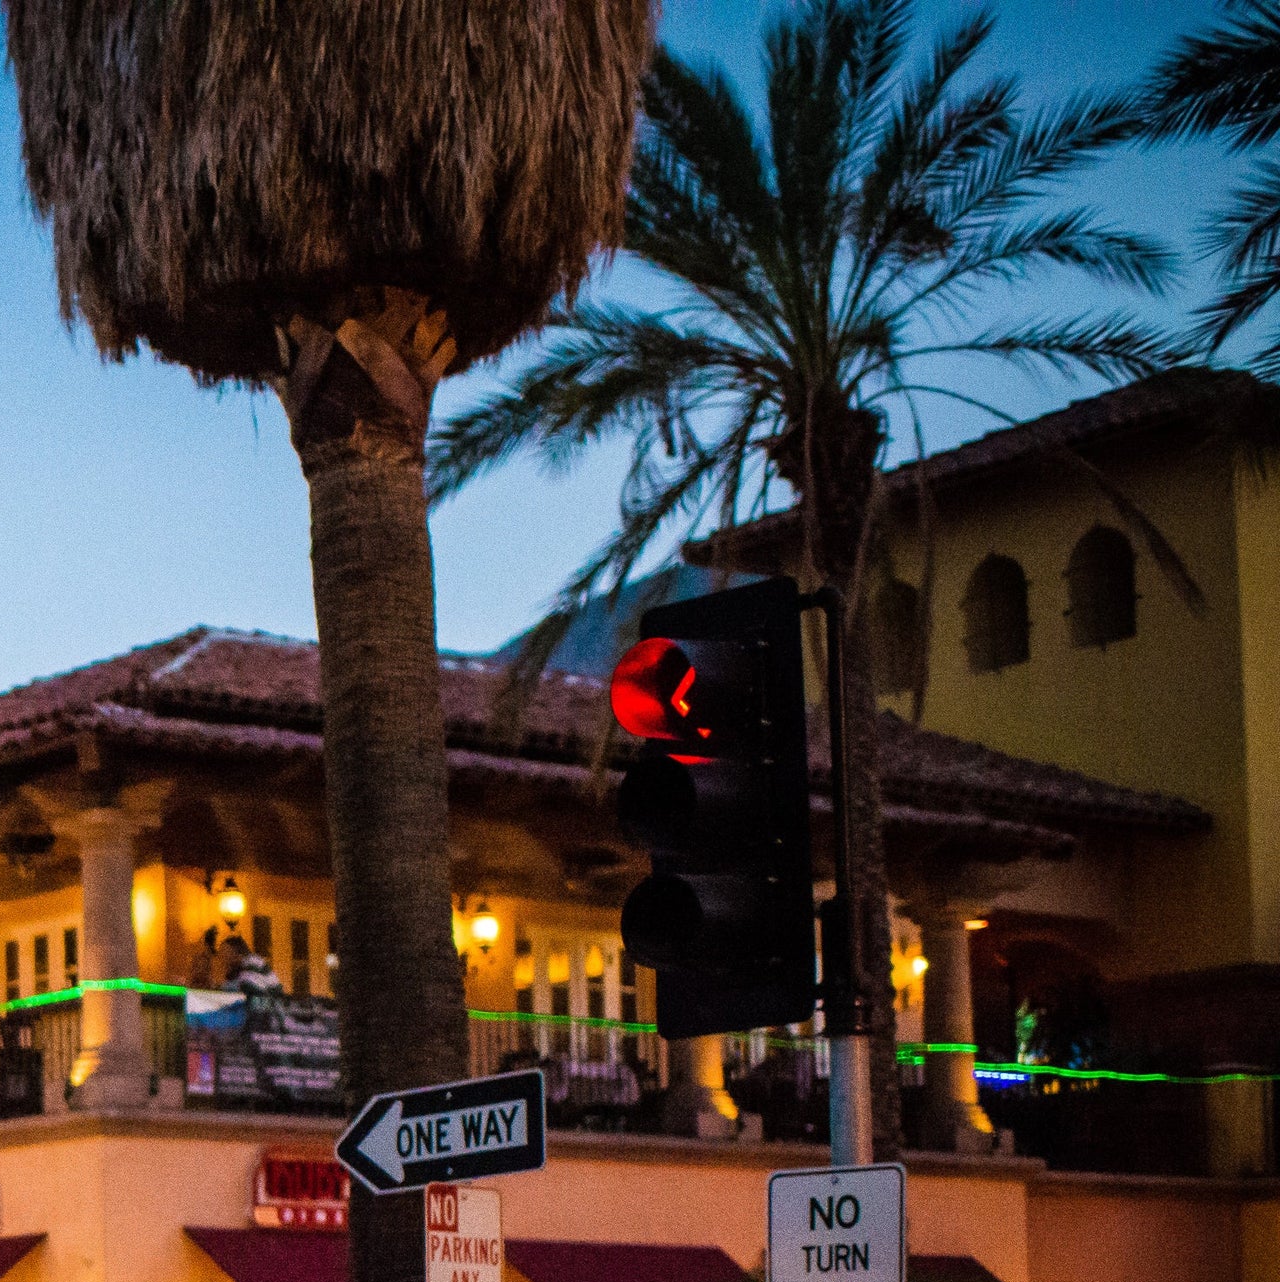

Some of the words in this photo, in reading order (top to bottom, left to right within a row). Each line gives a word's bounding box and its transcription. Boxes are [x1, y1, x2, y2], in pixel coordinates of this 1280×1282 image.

[396, 1117, 452, 1159] ONE
[461, 1107, 519, 1148] WAY
[430, 1193, 456, 1228] NO
[808, 1195, 860, 1231] NO
[429, 1235, 500, 1265] PARKING
[801, 1243, 870, 1273] TURN
